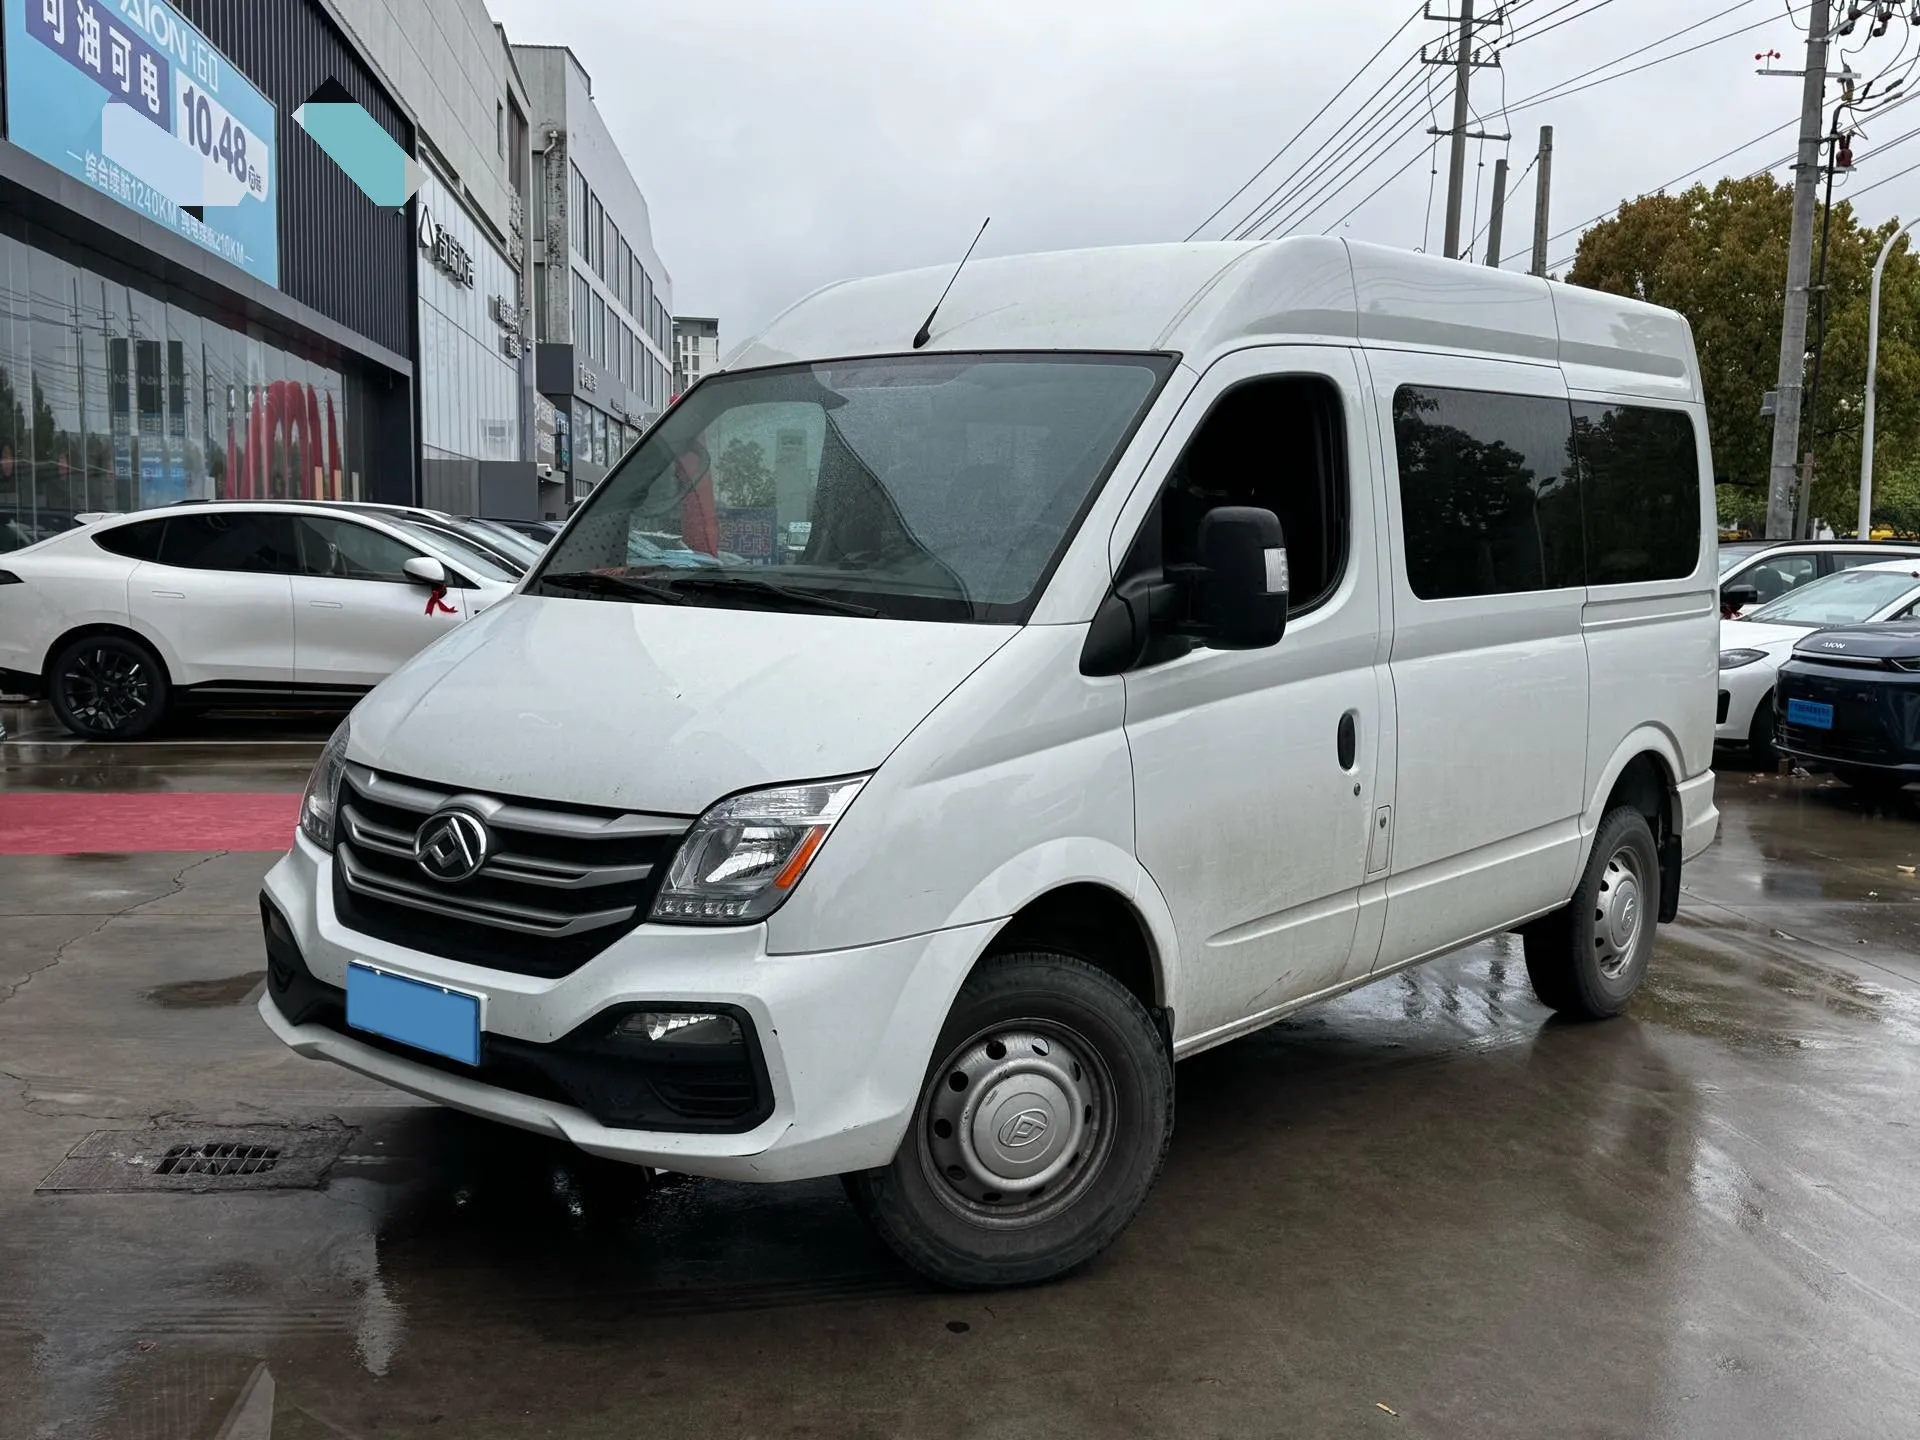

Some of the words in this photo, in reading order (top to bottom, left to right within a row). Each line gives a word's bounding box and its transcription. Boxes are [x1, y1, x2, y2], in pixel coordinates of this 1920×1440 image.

[42, 0, 160, 115] 可油可电
[1821, 641, 1846, 649] AION
